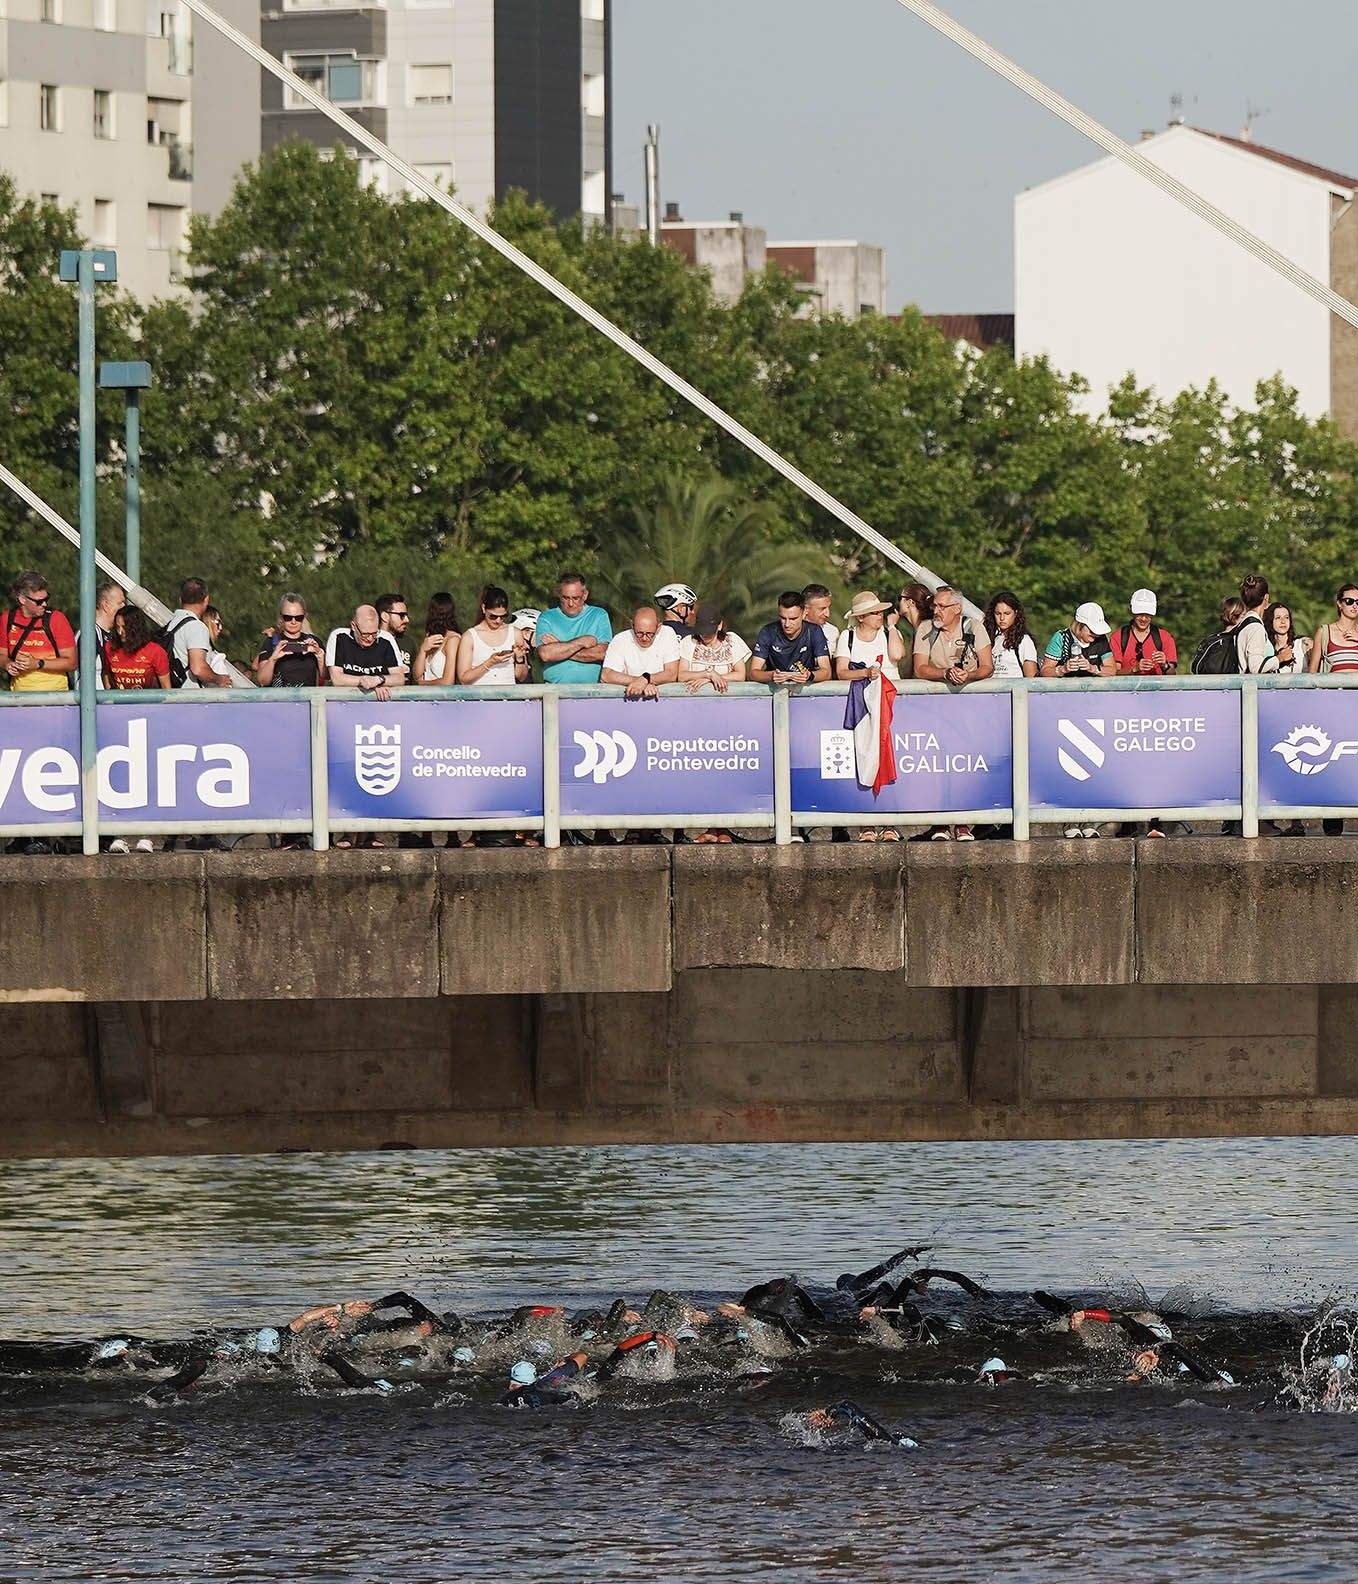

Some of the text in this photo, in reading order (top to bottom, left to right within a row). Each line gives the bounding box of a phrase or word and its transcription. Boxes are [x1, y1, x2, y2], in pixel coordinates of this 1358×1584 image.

[1113, 717, 1206, 734] DEPORTE
[646, 734, 760, 758] Deputación
[894, 733, 941, 751] NTA
[1113, 736, 1197, 752] GALEGO
[411, 745, 482, 760] Concello
[412, 763, 528, 778] de Pontevedra
[647, 755, 760, 771] Pontevedra
[898, 754, 990, 774] GALICIA
